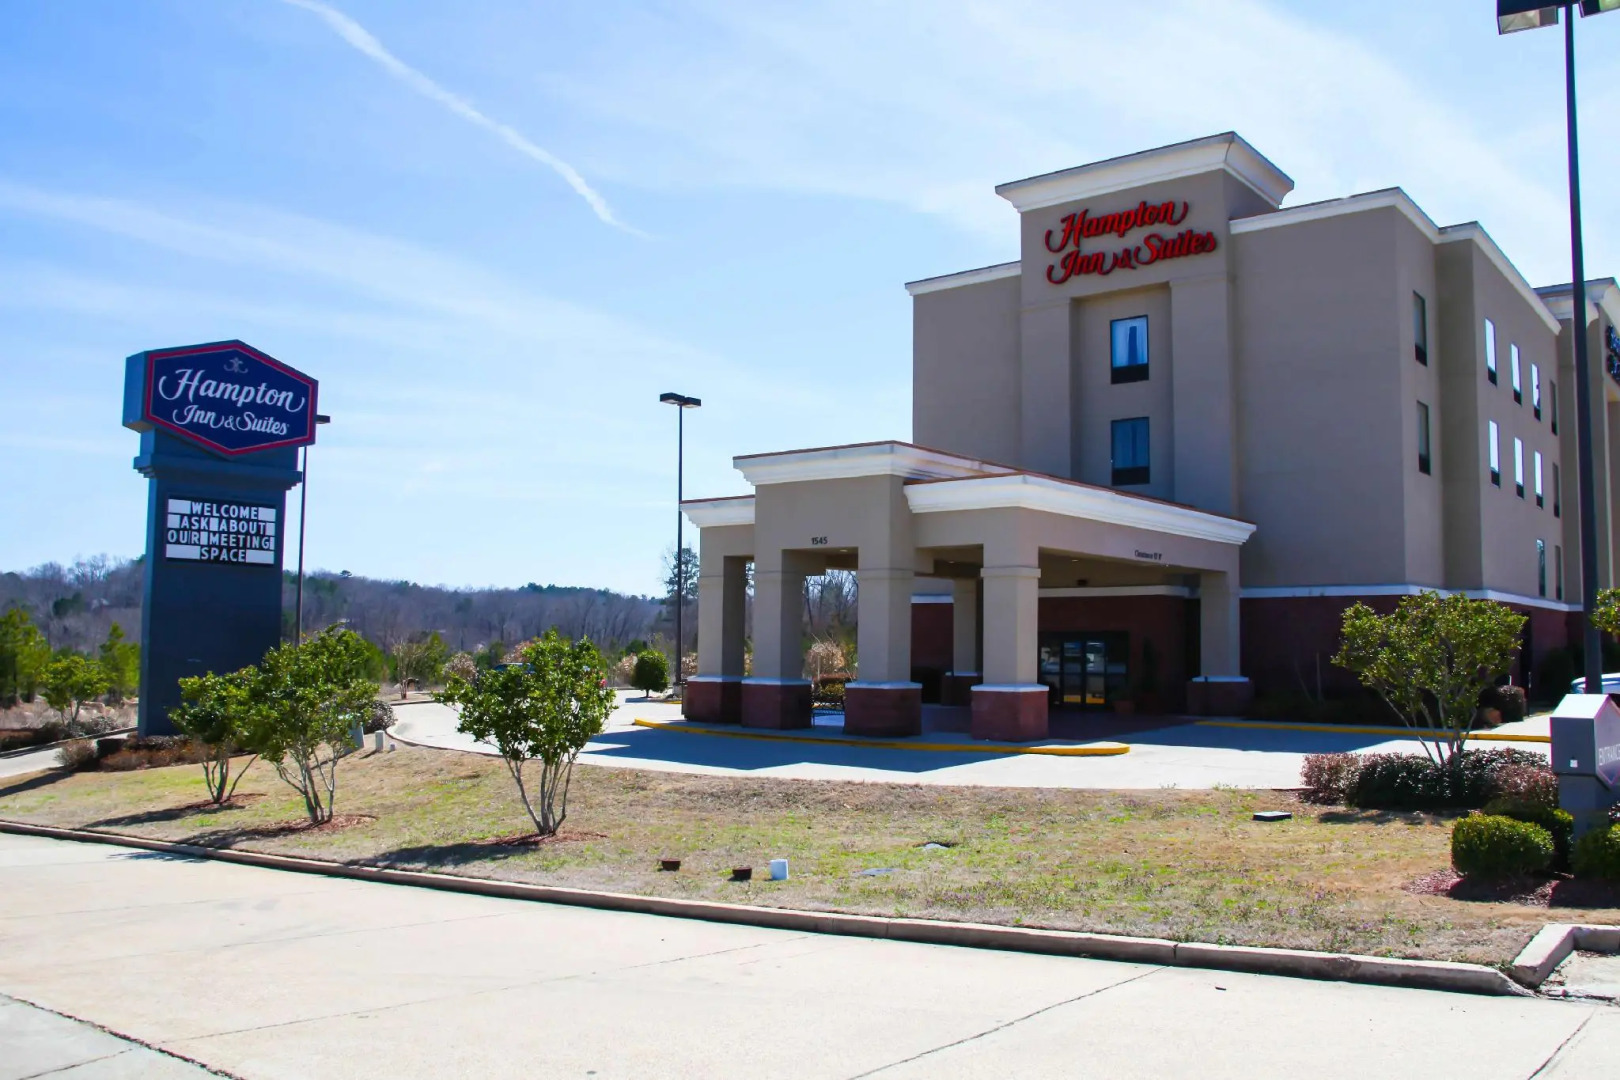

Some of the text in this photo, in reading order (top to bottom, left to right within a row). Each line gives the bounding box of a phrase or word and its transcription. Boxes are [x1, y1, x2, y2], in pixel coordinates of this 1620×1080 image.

[1044, 199, 1190, 253] Hampton
[1046, 228, 1217, 285] Inn & Suites
[158, 368, 306, 413] Hampton
[172, 404, 288, 436] Inn & Suites
[191, 501, 259, 520] WELCOME
[180, 515, 266, 535] ASK ABOUT
[167, 529, 271, 550] OUR MEETING
[811, 536, 828, 545] 1545
[200, 547, 246, 563] SPACE
